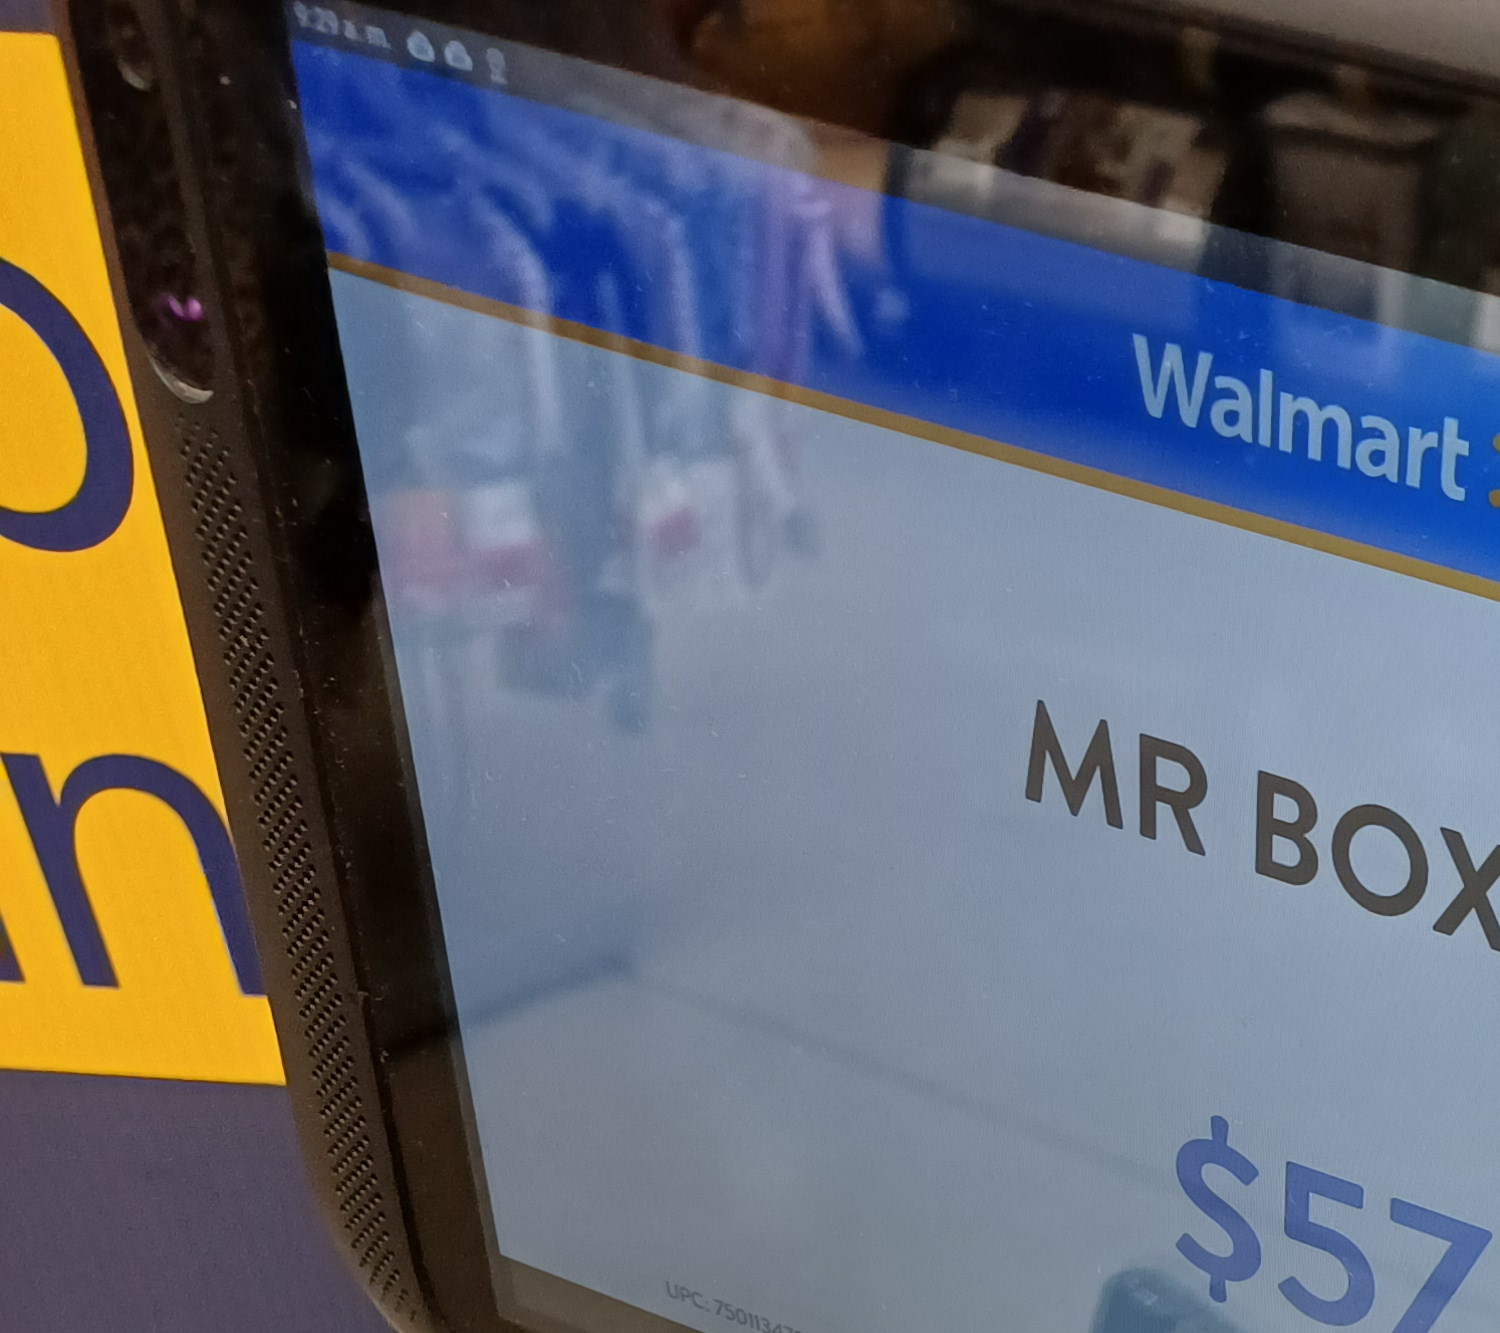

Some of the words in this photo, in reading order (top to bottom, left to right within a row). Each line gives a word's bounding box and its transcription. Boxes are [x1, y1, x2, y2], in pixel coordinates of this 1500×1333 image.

[1131, 332, 1470, 502] Walmart
[1024, 698, 1209, 857] MR
[665, 1280, 710, 1312] UPC:
